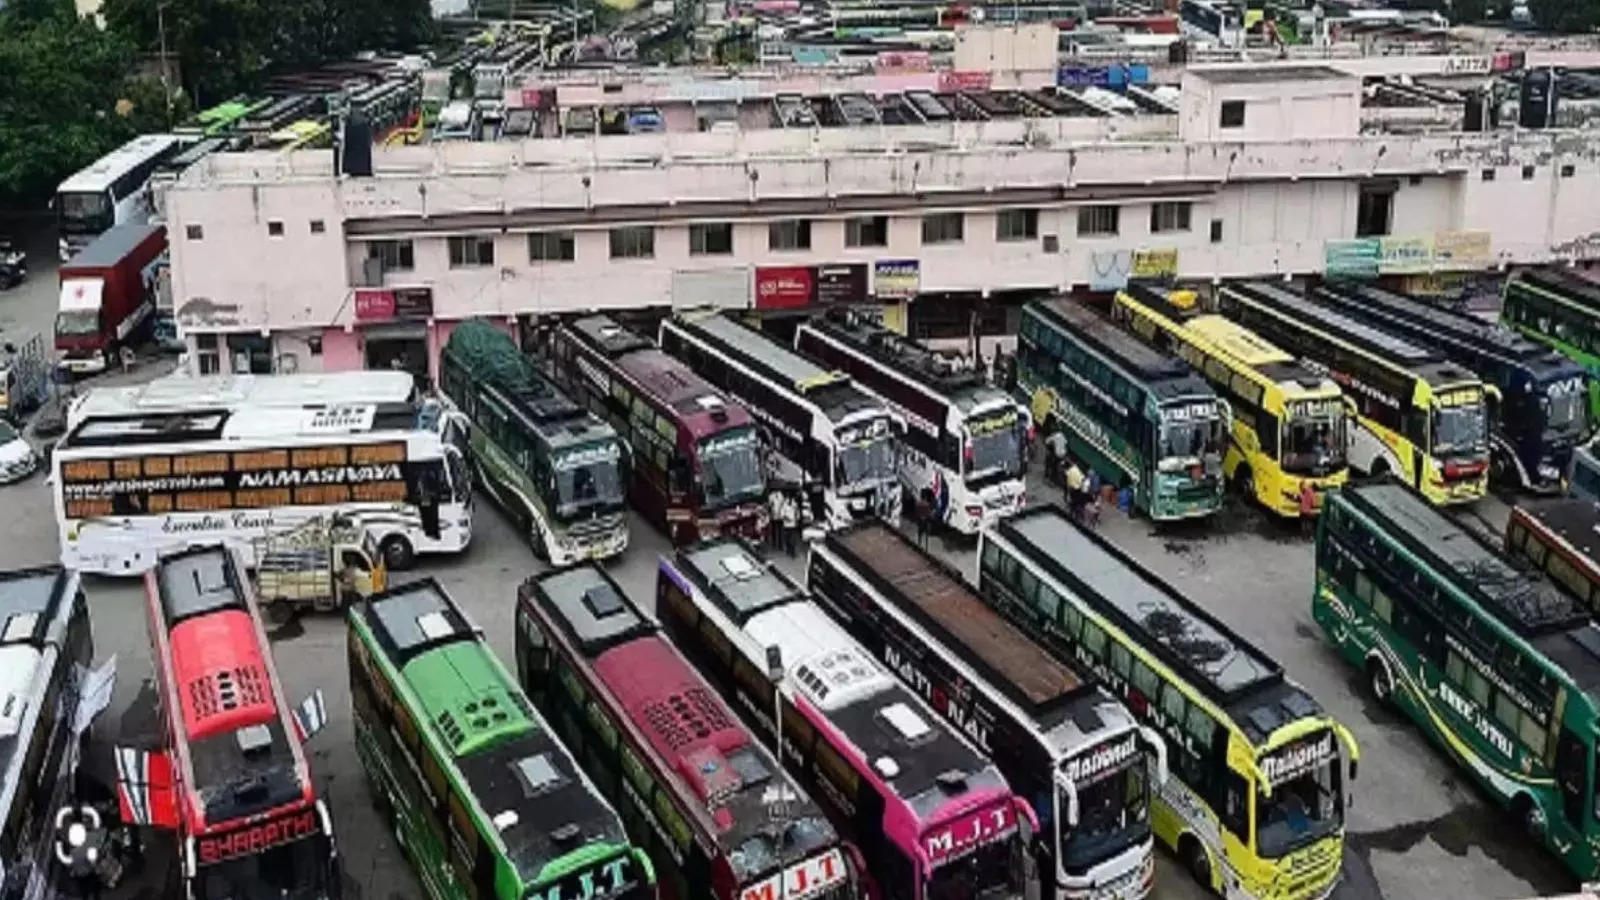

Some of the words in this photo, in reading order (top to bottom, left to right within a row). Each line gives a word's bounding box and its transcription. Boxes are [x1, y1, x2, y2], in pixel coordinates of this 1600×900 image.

[239, 463, 403, 488] NAMASIVAYA
[884, 643, 994, 755] NATIONAL
[200, 809, 315, 863] BHARATHI
[927, 807, 1008, 858] M.J.T
[526, 855, 630, 900] J.T
[744, 852, 839, 900] MJ.T
